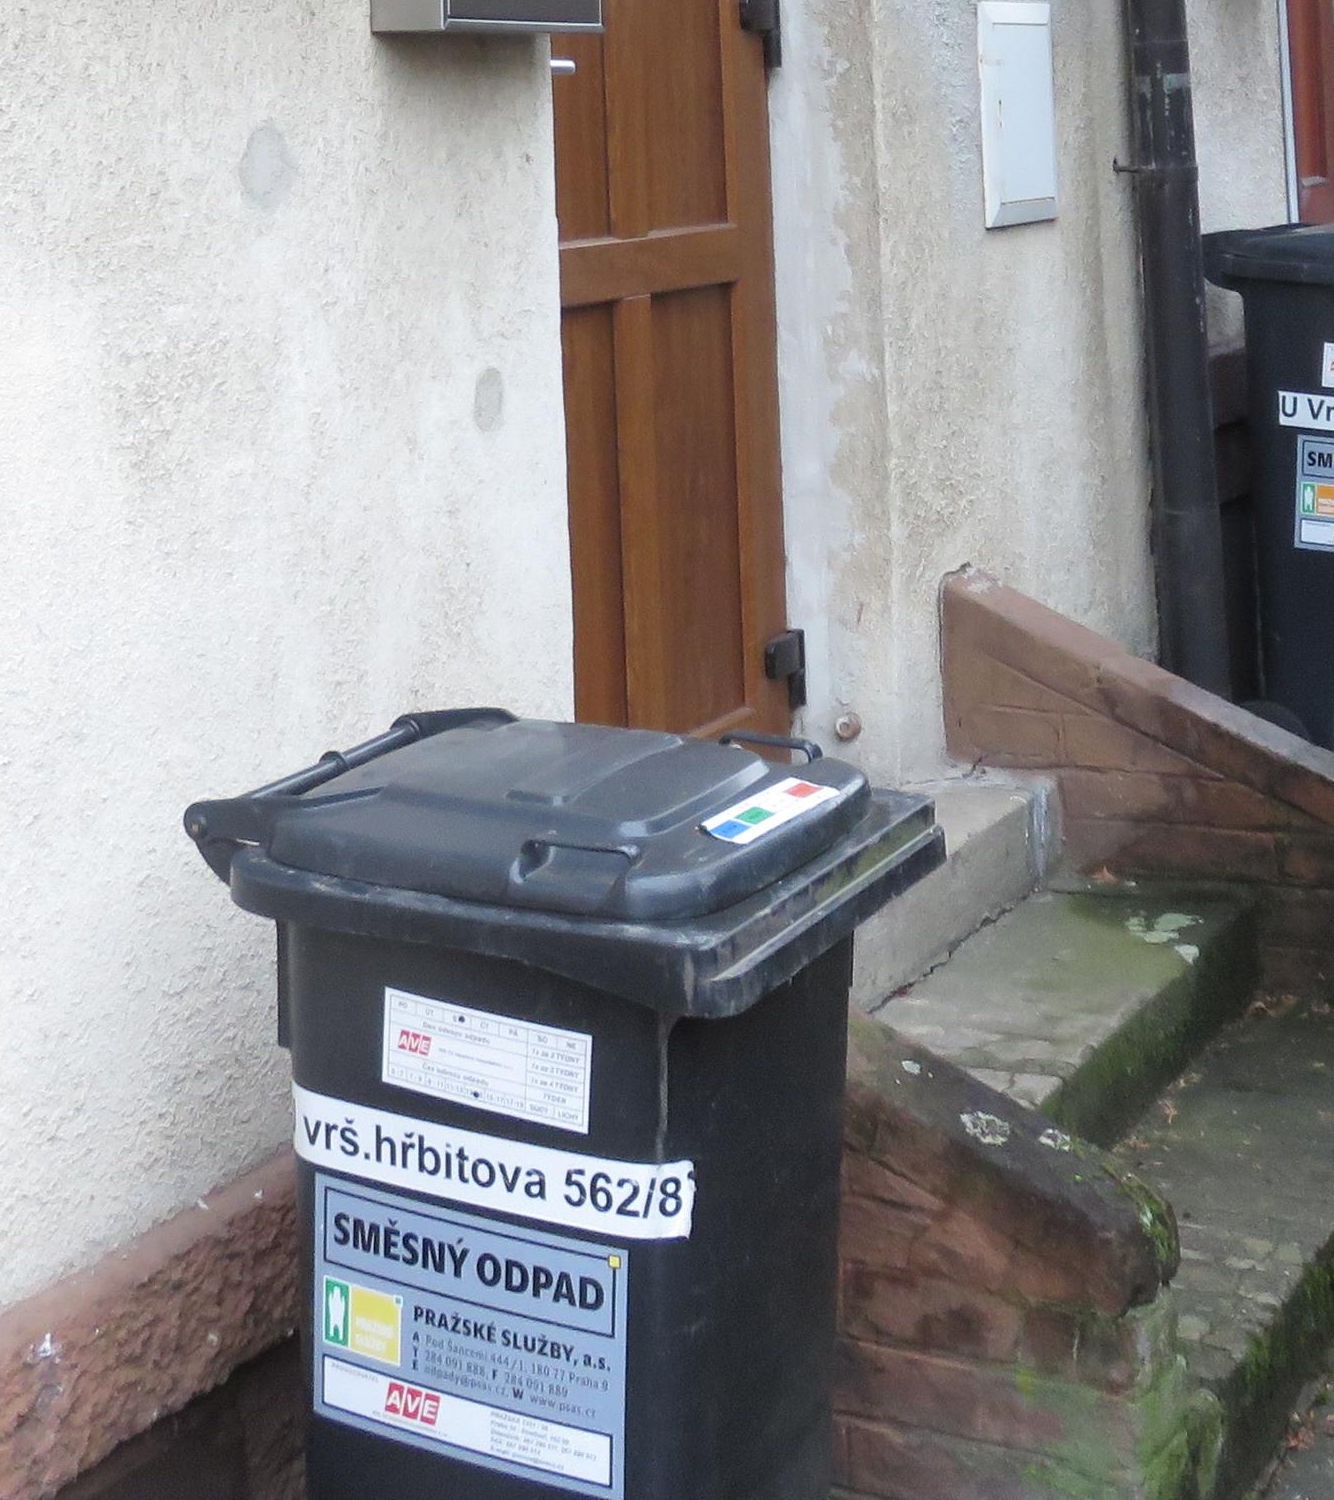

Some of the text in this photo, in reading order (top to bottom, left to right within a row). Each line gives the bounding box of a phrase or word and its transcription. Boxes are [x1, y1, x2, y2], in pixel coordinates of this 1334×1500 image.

[1281, 395, 1298, 418] U
[398, 1030, 431, 1056] AVE
[303, 1114, 695, 1219] vrš.hřbitova 562/8
[334, 1210, 605, 1312] SMĚSNÝ ODPAD
[413, 1305, 497, 1344] PRAŽSKÉ
[501, 1330, 579, 1367] SLUŽBY,
[583, 1353, 611, 1372] a.s.
[412, 1331, 420, 1343] A
[425, 1335, 446, 1348] Pod
[568, 1373, 599, 1391] Praha
[601, 1381, 609, 1392] 9
[412, 1347, 419, 1358] T
[425, 1349, 444, 1365] 284
[445, 1354, 463, 1371] 091
[492, 1368, 498, 1381] F
[412, 1359, 419, 1371] E
[511, 1387, 524, 1400] W
[386, 1386, 439, 1422] AVE
